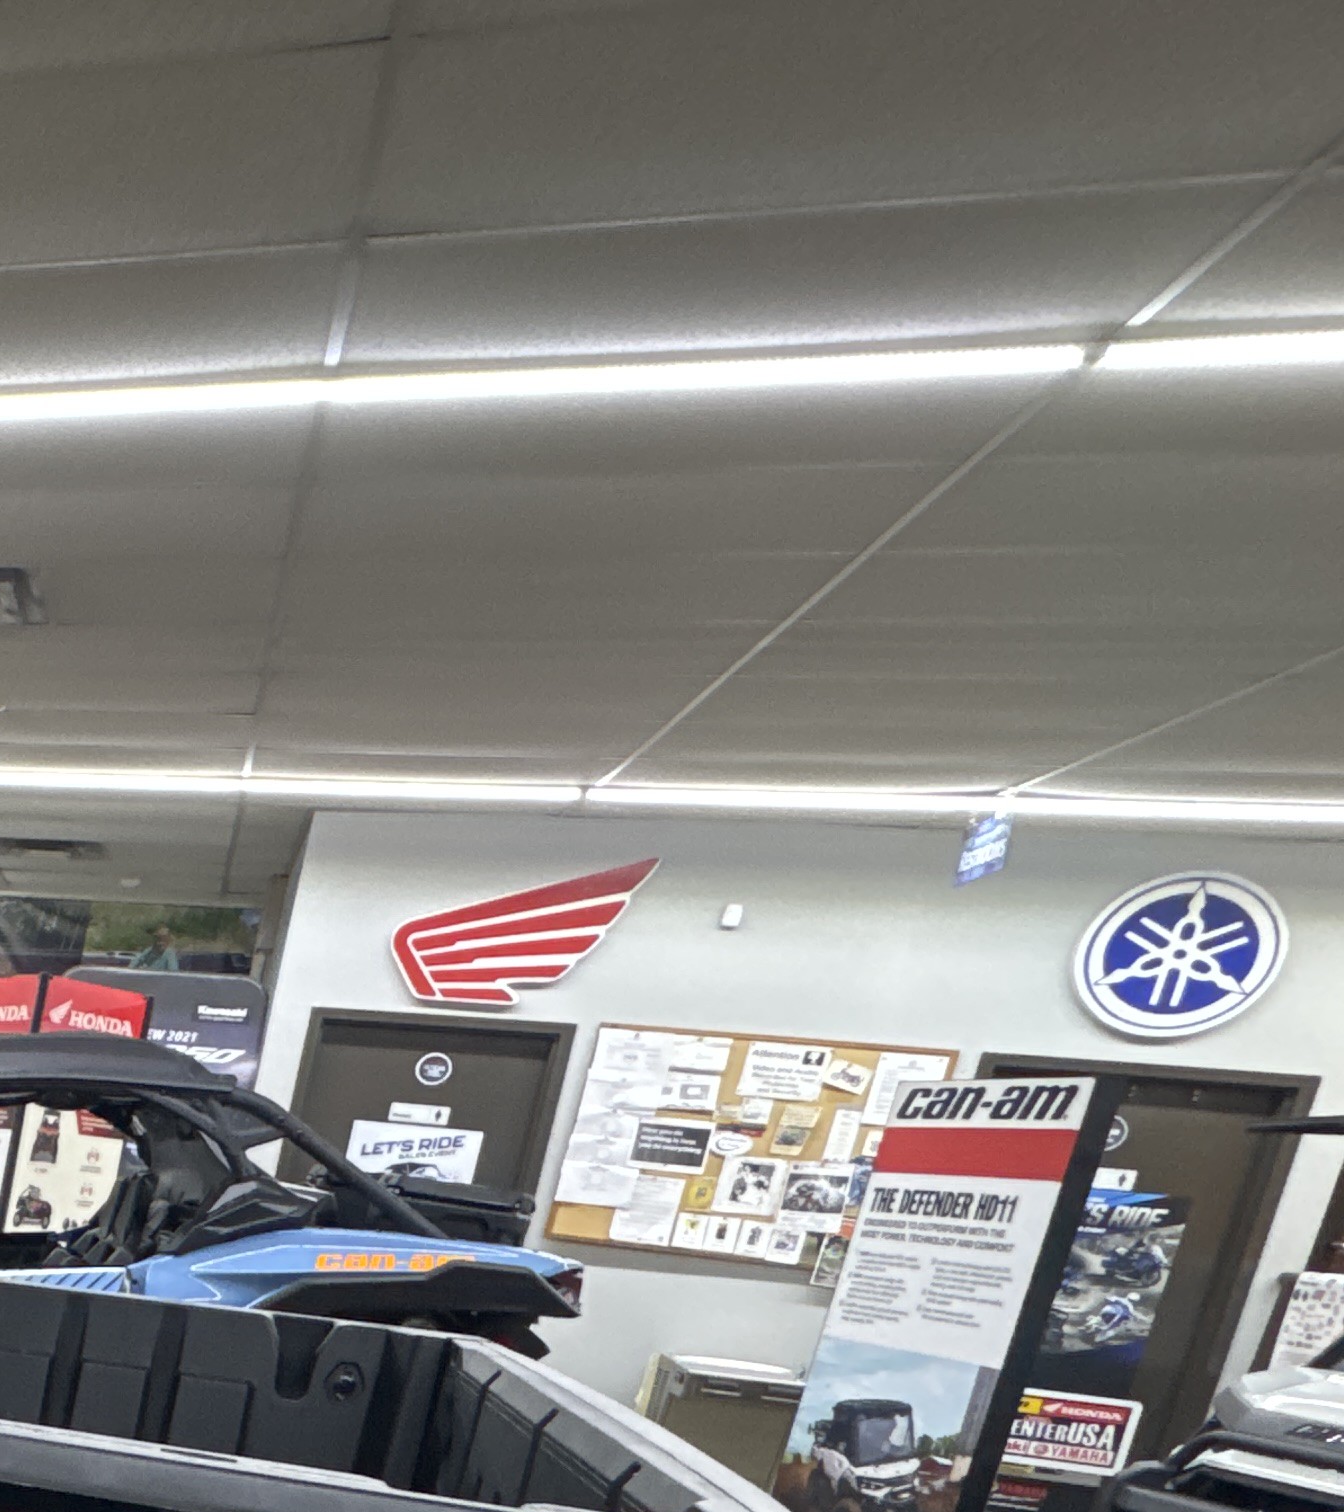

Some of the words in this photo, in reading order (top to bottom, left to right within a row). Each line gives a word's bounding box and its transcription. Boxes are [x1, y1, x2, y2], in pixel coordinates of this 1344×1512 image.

[68, 1011, 133, 1036] HONDA
[147, 1028, 166, 1041] EW
[166, 1030, 199, 1043] 2021
[896, 1084, 1079, 1121] can-am
[360, 1138, 414, 1156] LET'S
[418, 1135, 466, 1151] RIDE
[870, 1187, 899, 1213] THE
[898, 1188, 975, 1220] DEFENDER
[973, 1194, 1020, 1224] HD11
[1061, 1406, 1123, 1422] HONDA
[1009, 1417, 1117, 1452] ENTERUSA
[1050, 1443, 1110, 1464] YAMAHA
